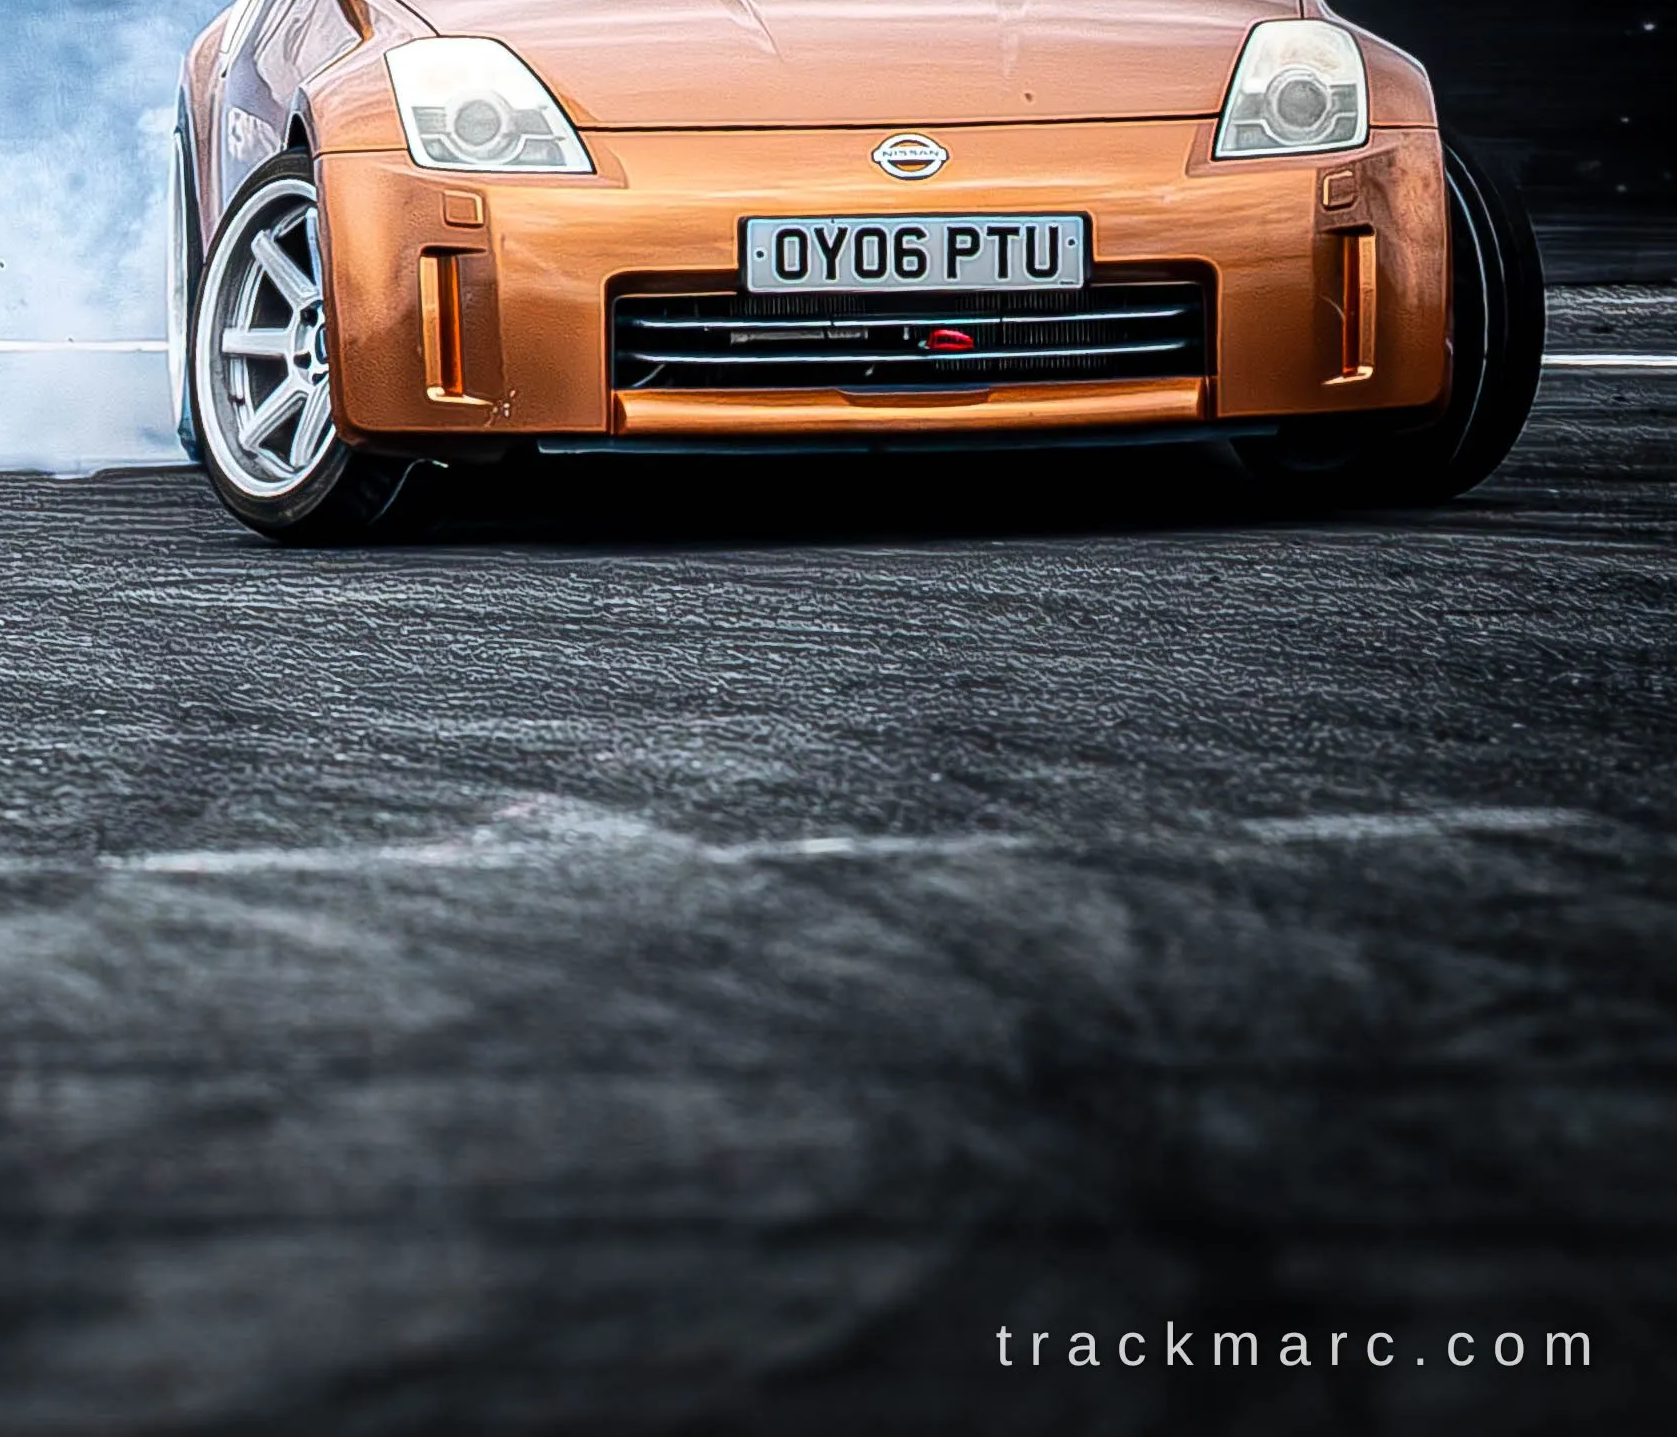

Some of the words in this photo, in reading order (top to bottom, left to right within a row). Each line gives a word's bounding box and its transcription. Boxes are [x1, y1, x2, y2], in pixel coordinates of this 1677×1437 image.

[882, 149, 940, 157] NISSAN
[774, 226, 929, 281] OY06
[945, 225, 1060, 279] PTU
